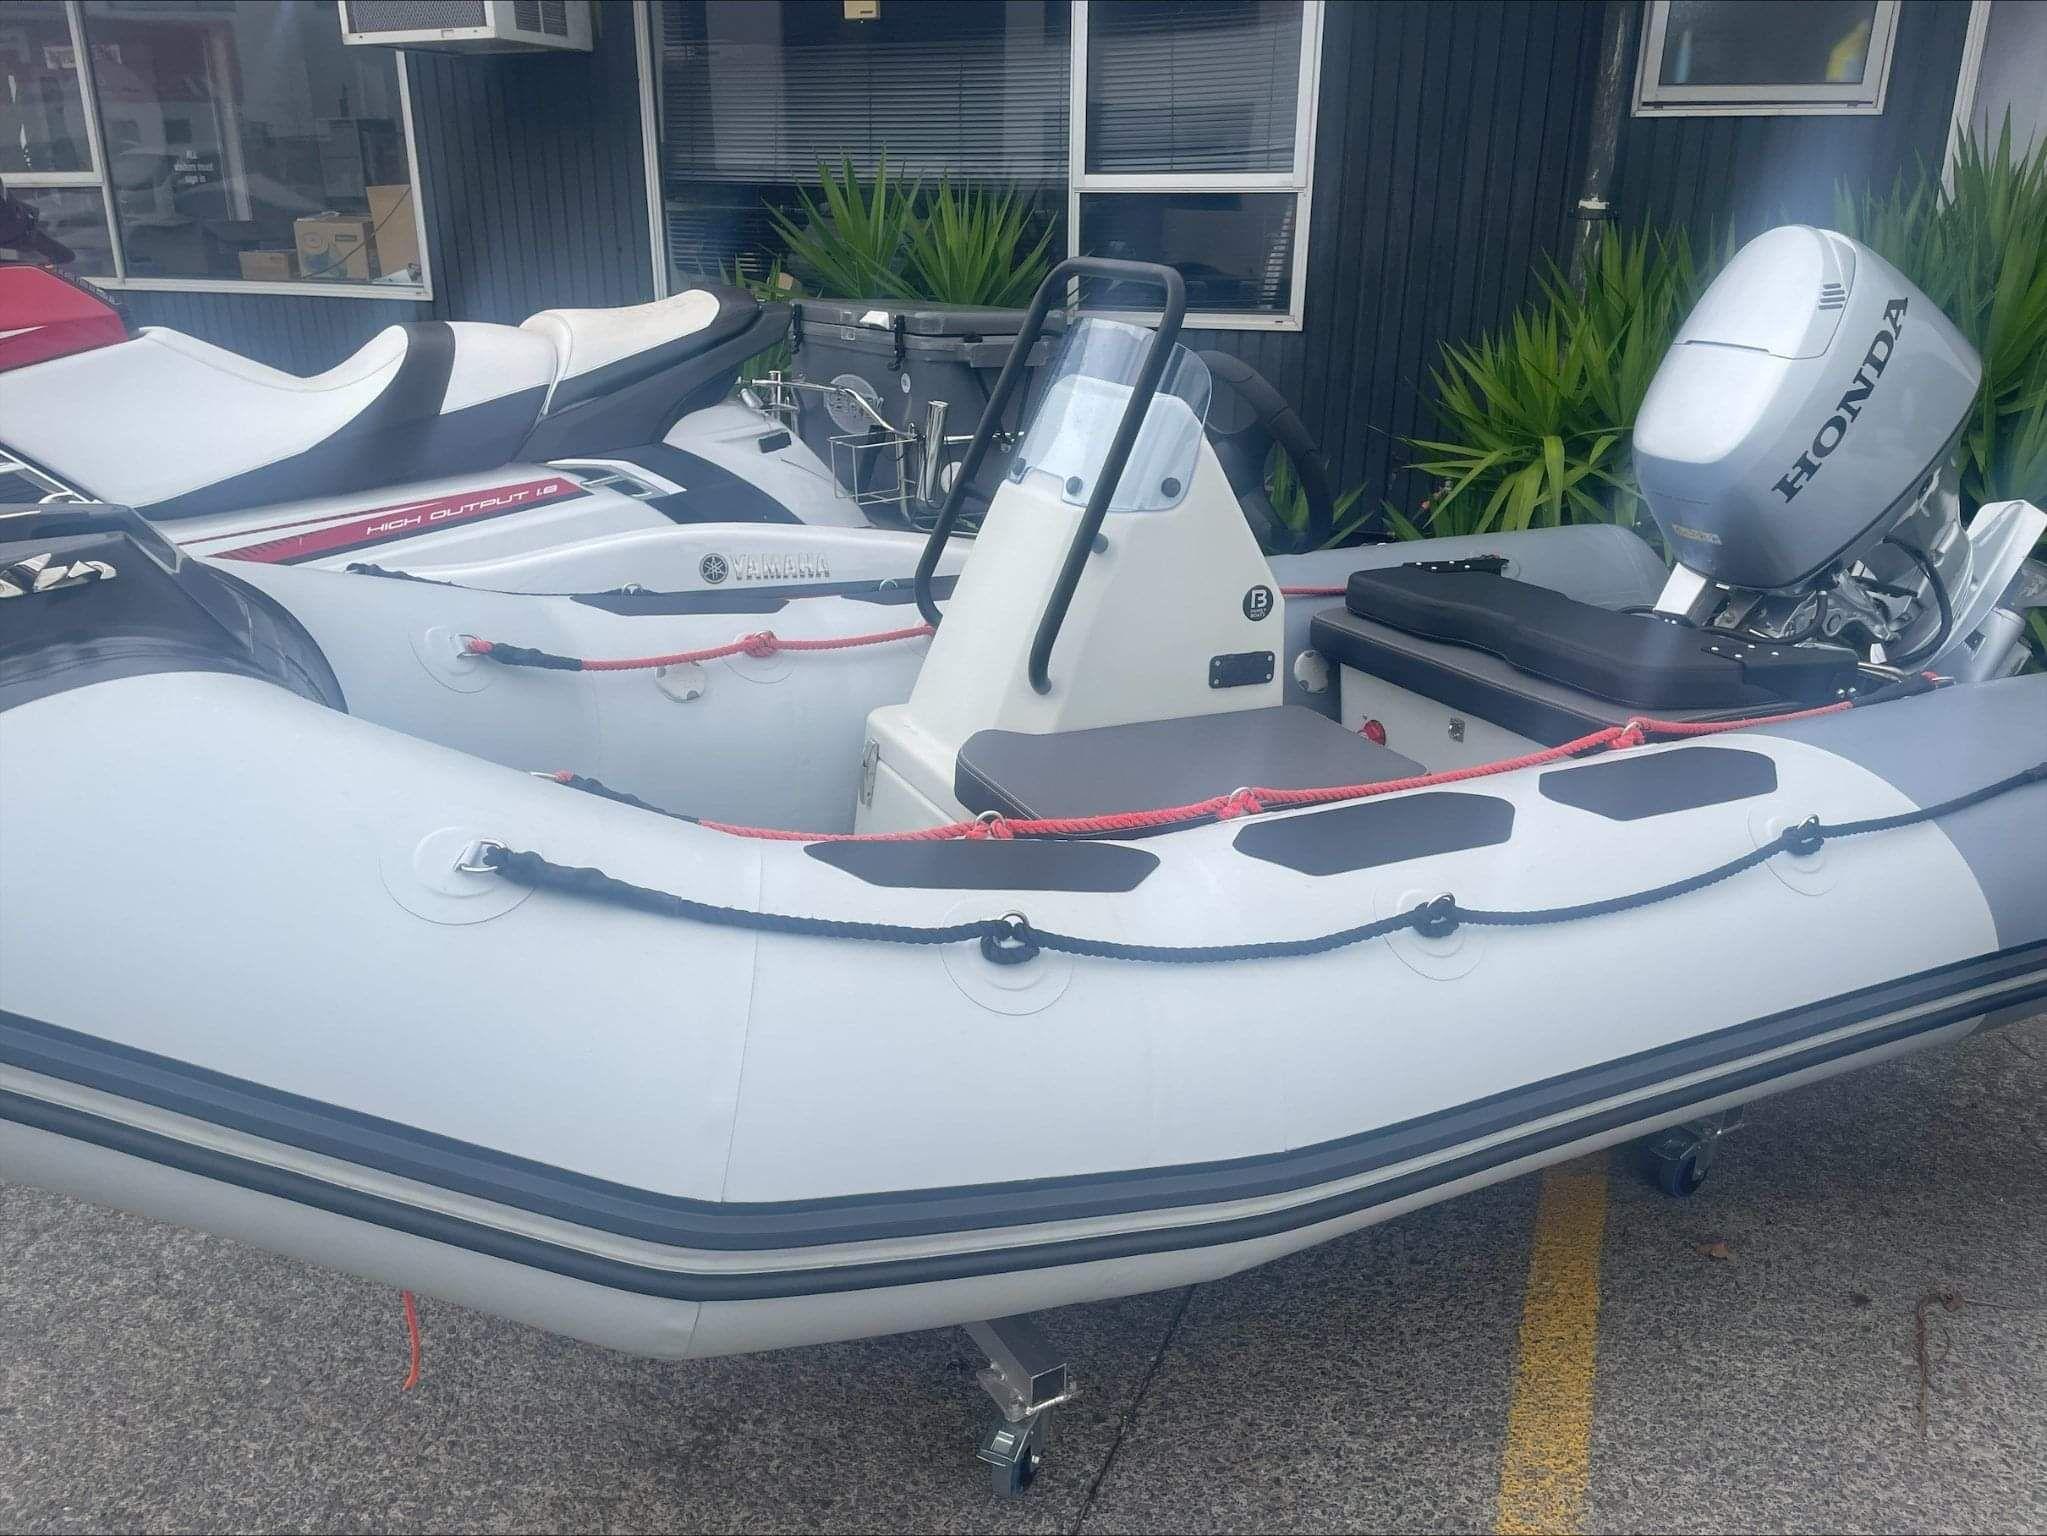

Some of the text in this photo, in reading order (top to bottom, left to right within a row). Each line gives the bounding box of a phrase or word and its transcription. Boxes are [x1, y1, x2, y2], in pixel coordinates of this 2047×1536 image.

[1771, 297, 1909, 504] HONDA
[366, 484, 558, 536] HIGH OUTPUT 1.8
[729, 552, 832, 581] YAMAHA
